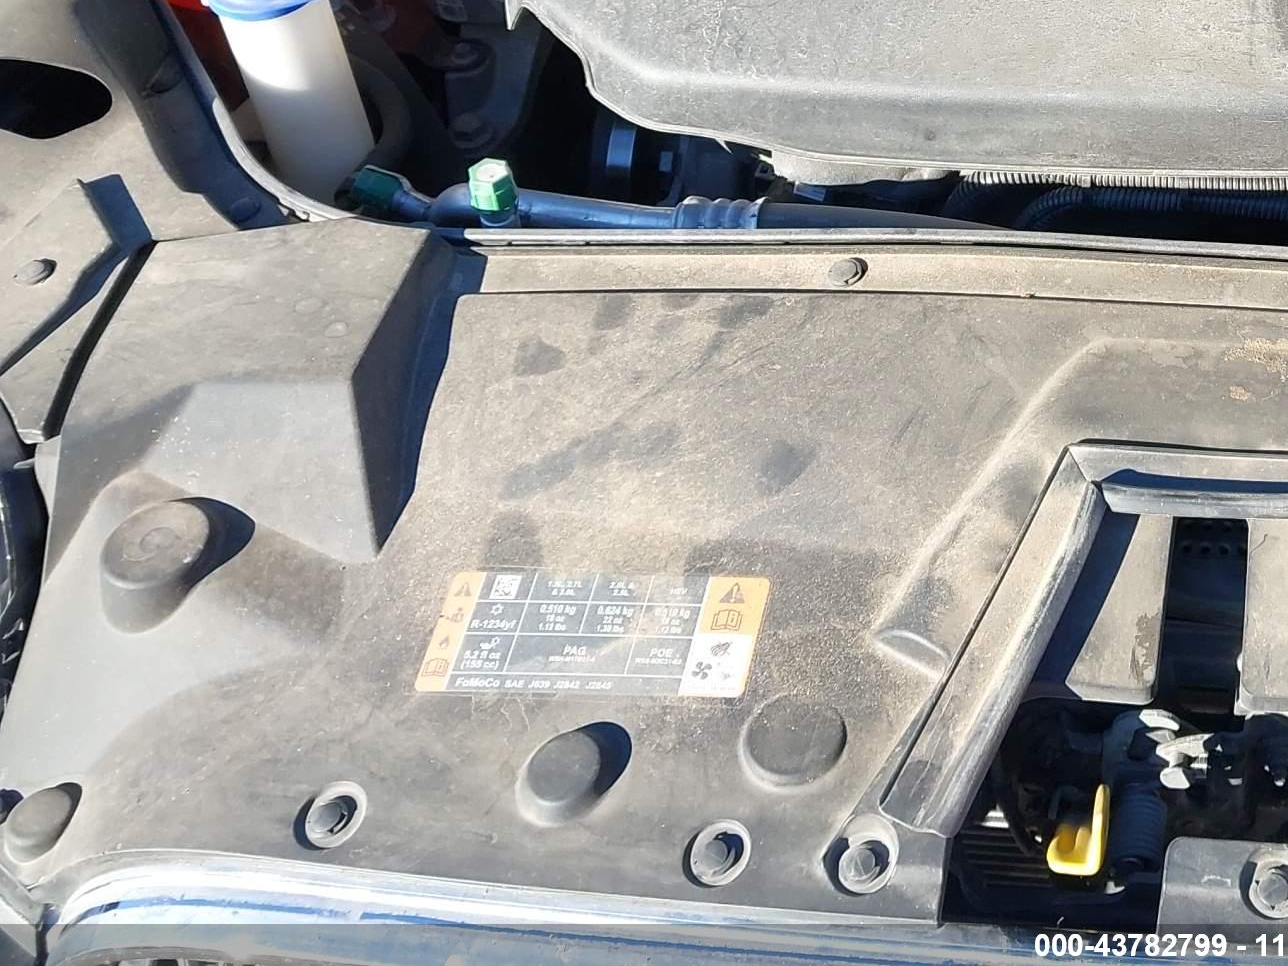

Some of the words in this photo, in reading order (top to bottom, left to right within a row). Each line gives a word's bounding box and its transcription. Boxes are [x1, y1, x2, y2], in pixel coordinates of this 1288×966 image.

[539, 604, 564, 614] 0.510
[564, 604, 577, 616] kg
[597, 605, 622, 615] 0.624
[622, 605, 634, 618] kg
[679, 608, 691, 620] kg
[470, 619, 516, 631] R-1234yf
[602, 616, 614, 624] 22
[562, 644, 587, 655] PAG
[649, 648, 673, 658] POE
[455, 677, 500, 687] FoMoCo
[504, 679, 524, 688] SAE
